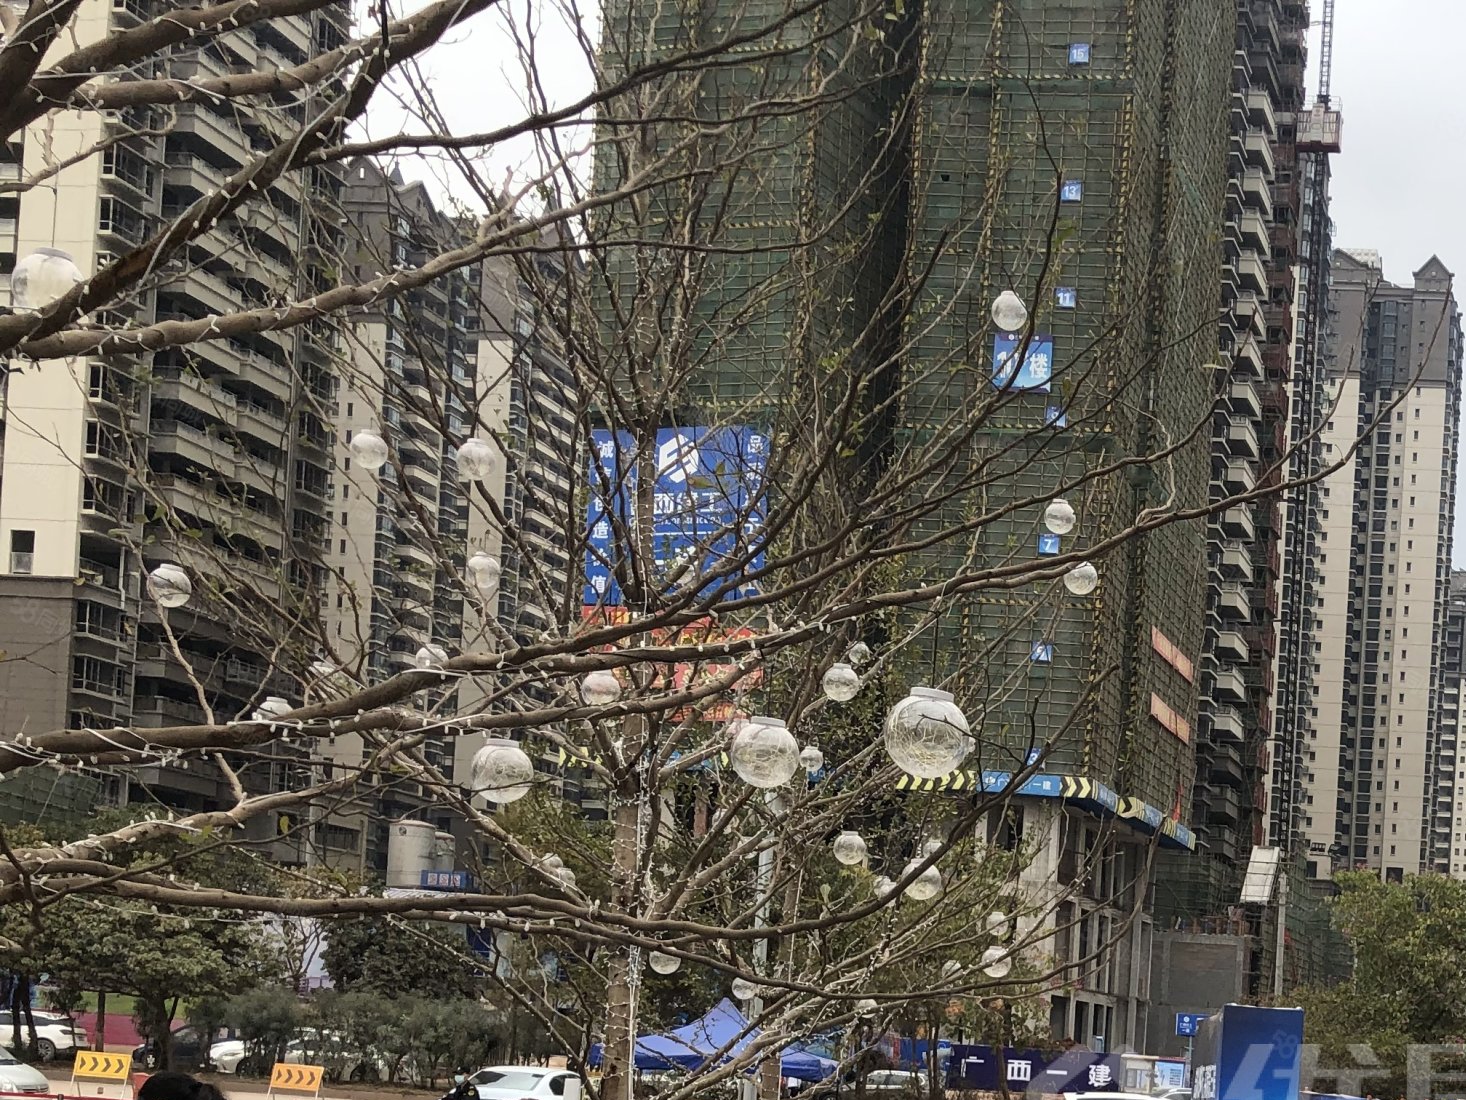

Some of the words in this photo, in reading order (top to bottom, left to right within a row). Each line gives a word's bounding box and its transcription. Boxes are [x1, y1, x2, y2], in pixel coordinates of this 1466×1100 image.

[1057, 292, 1070, 305] 11
[960, 1056, 1113, 1087] 广西一建
